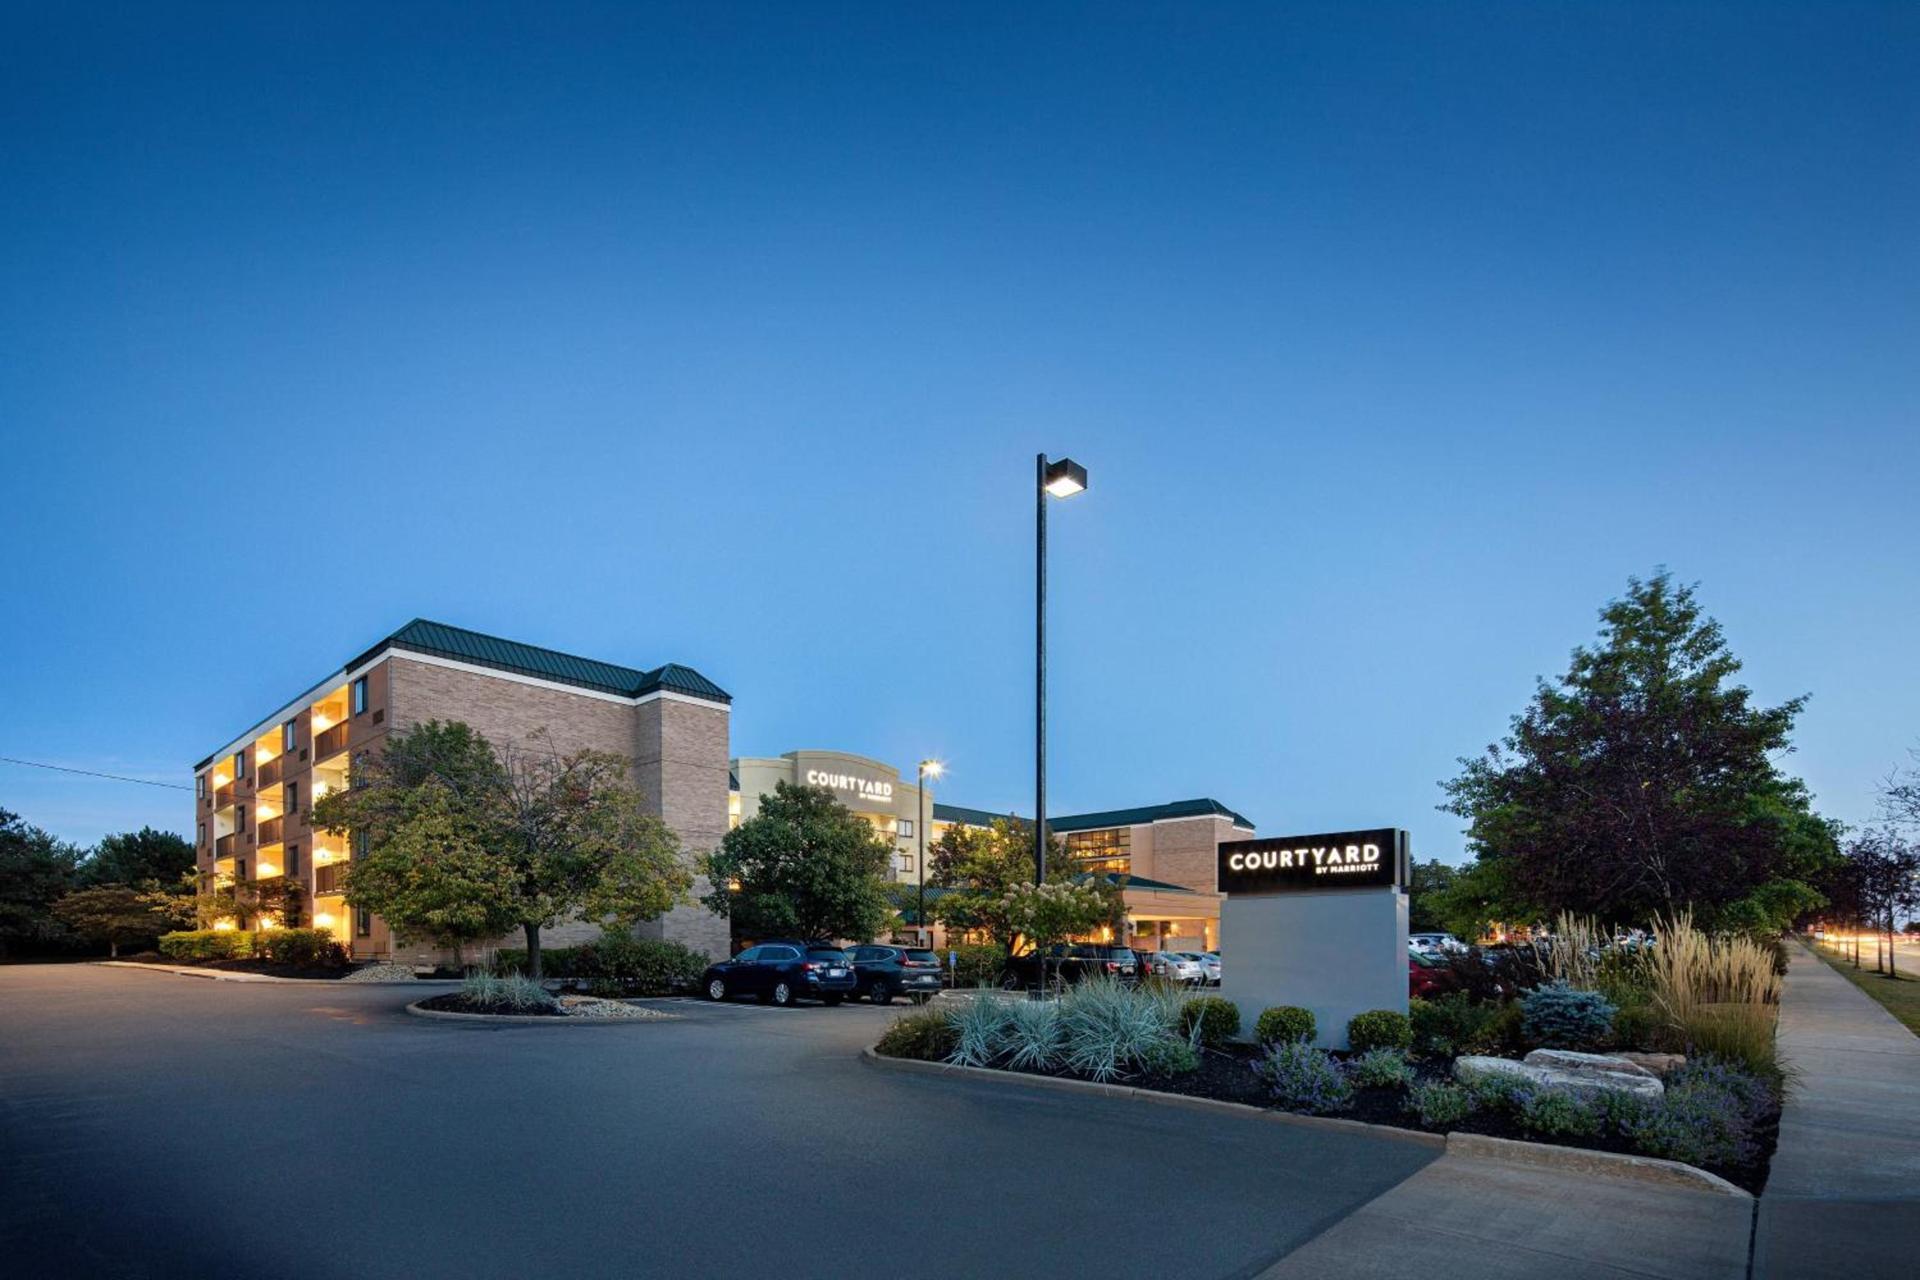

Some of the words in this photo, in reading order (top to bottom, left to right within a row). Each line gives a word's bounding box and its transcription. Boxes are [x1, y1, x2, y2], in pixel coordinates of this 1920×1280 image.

[807, 770, 892, 796] COURTYARD
[1229, 844, 1379, 870] COURTYARD
[1315, 866, 1327, 874] BY
[1330, 863, 1379, 873] MARRIOTT
